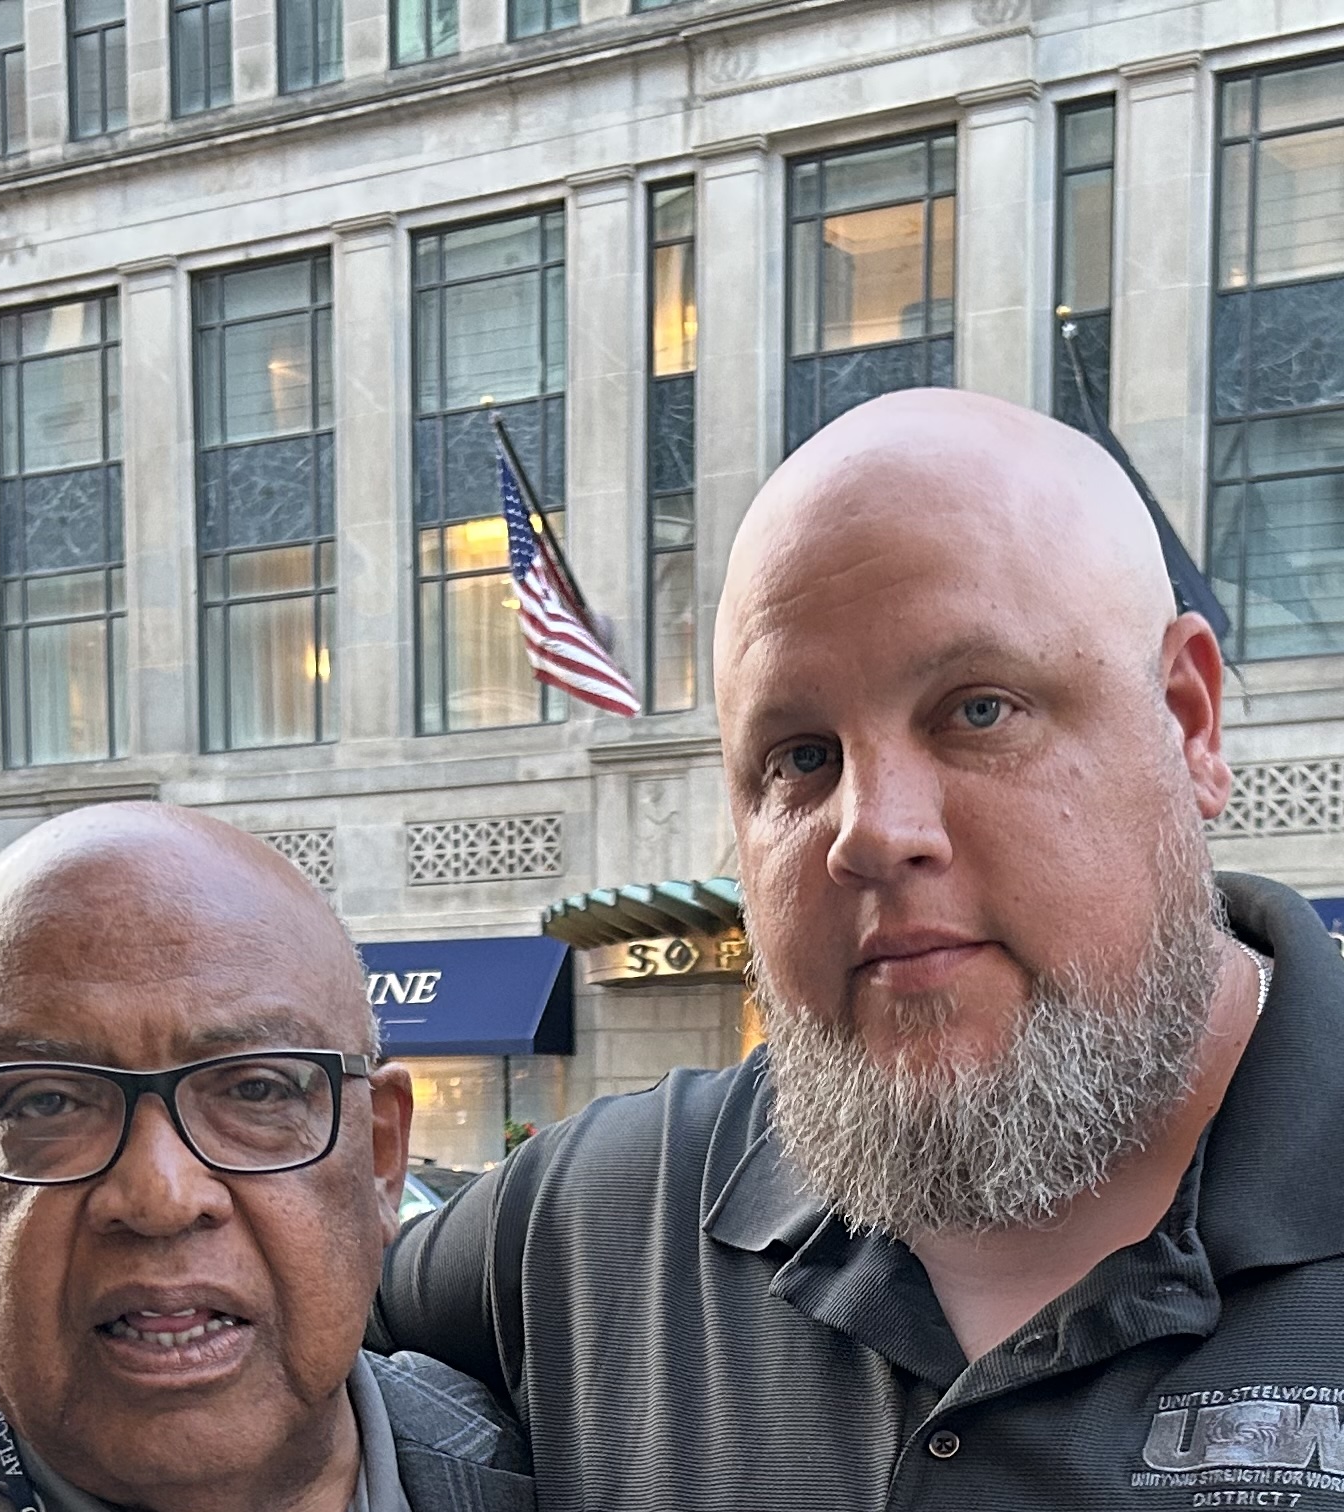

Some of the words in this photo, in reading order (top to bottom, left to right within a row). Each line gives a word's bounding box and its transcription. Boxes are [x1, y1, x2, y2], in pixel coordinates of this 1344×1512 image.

[1158, 1391, 1225, 1411] UNITED
[1198, 1468, 1269, 1485] STRENGTH
[1273, 1470, 1304, 1485] FOR
[1192, 1490, 1283, 1507] DISTRICT
[1288, 1492, 1302, 1508] 7
